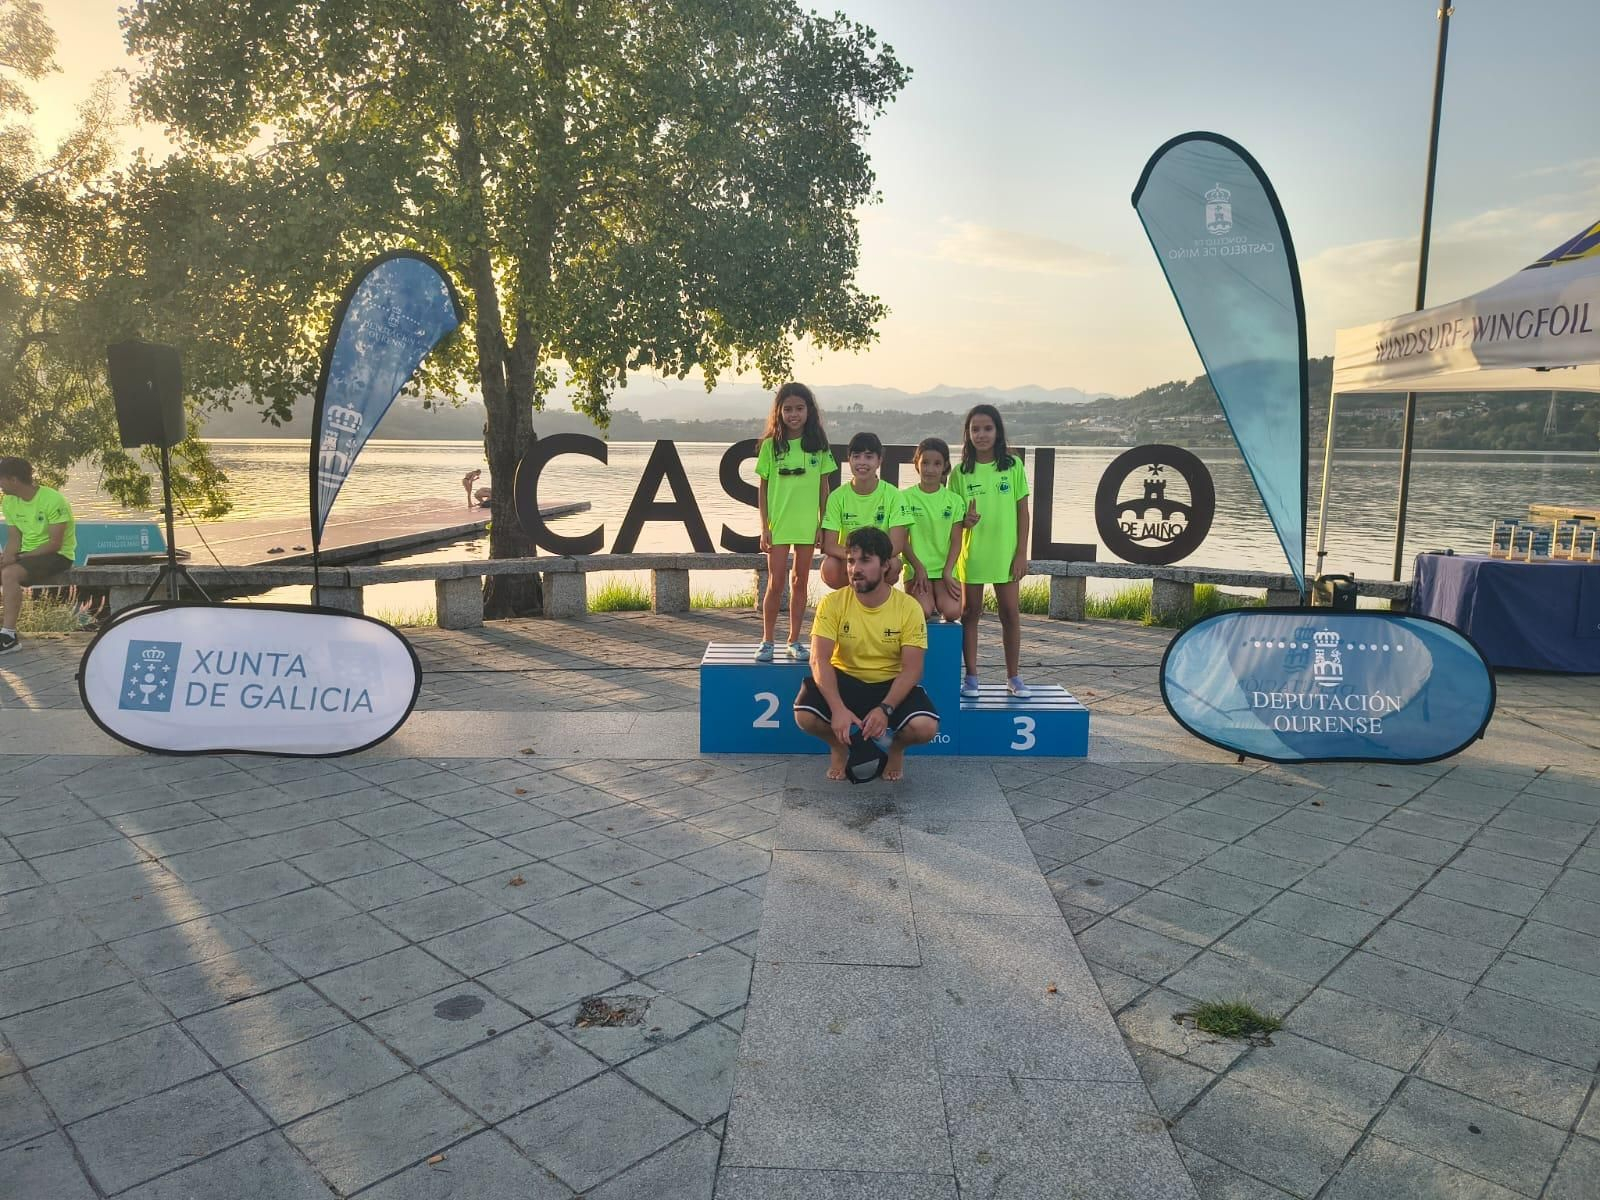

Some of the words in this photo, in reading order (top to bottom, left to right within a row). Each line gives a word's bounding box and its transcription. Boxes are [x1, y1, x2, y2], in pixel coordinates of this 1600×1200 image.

[514, 433, 1216, 566] CASLO
[1121, 522, 1138, 536] DE
[1142, 522, 1183, 539] MIÑO
[191, 649, 307, 678] XUNTA
[185, 681, 229, 707] DE
[240, 683, 373, 714] GALICIA
[752, 692, 780, 729] 2
[1252, 690, 1402, 713] DEPUTACIÓN
[1010, 716, 1037, 751] 3
[1274, 715, 1383, 735] OURENSE
